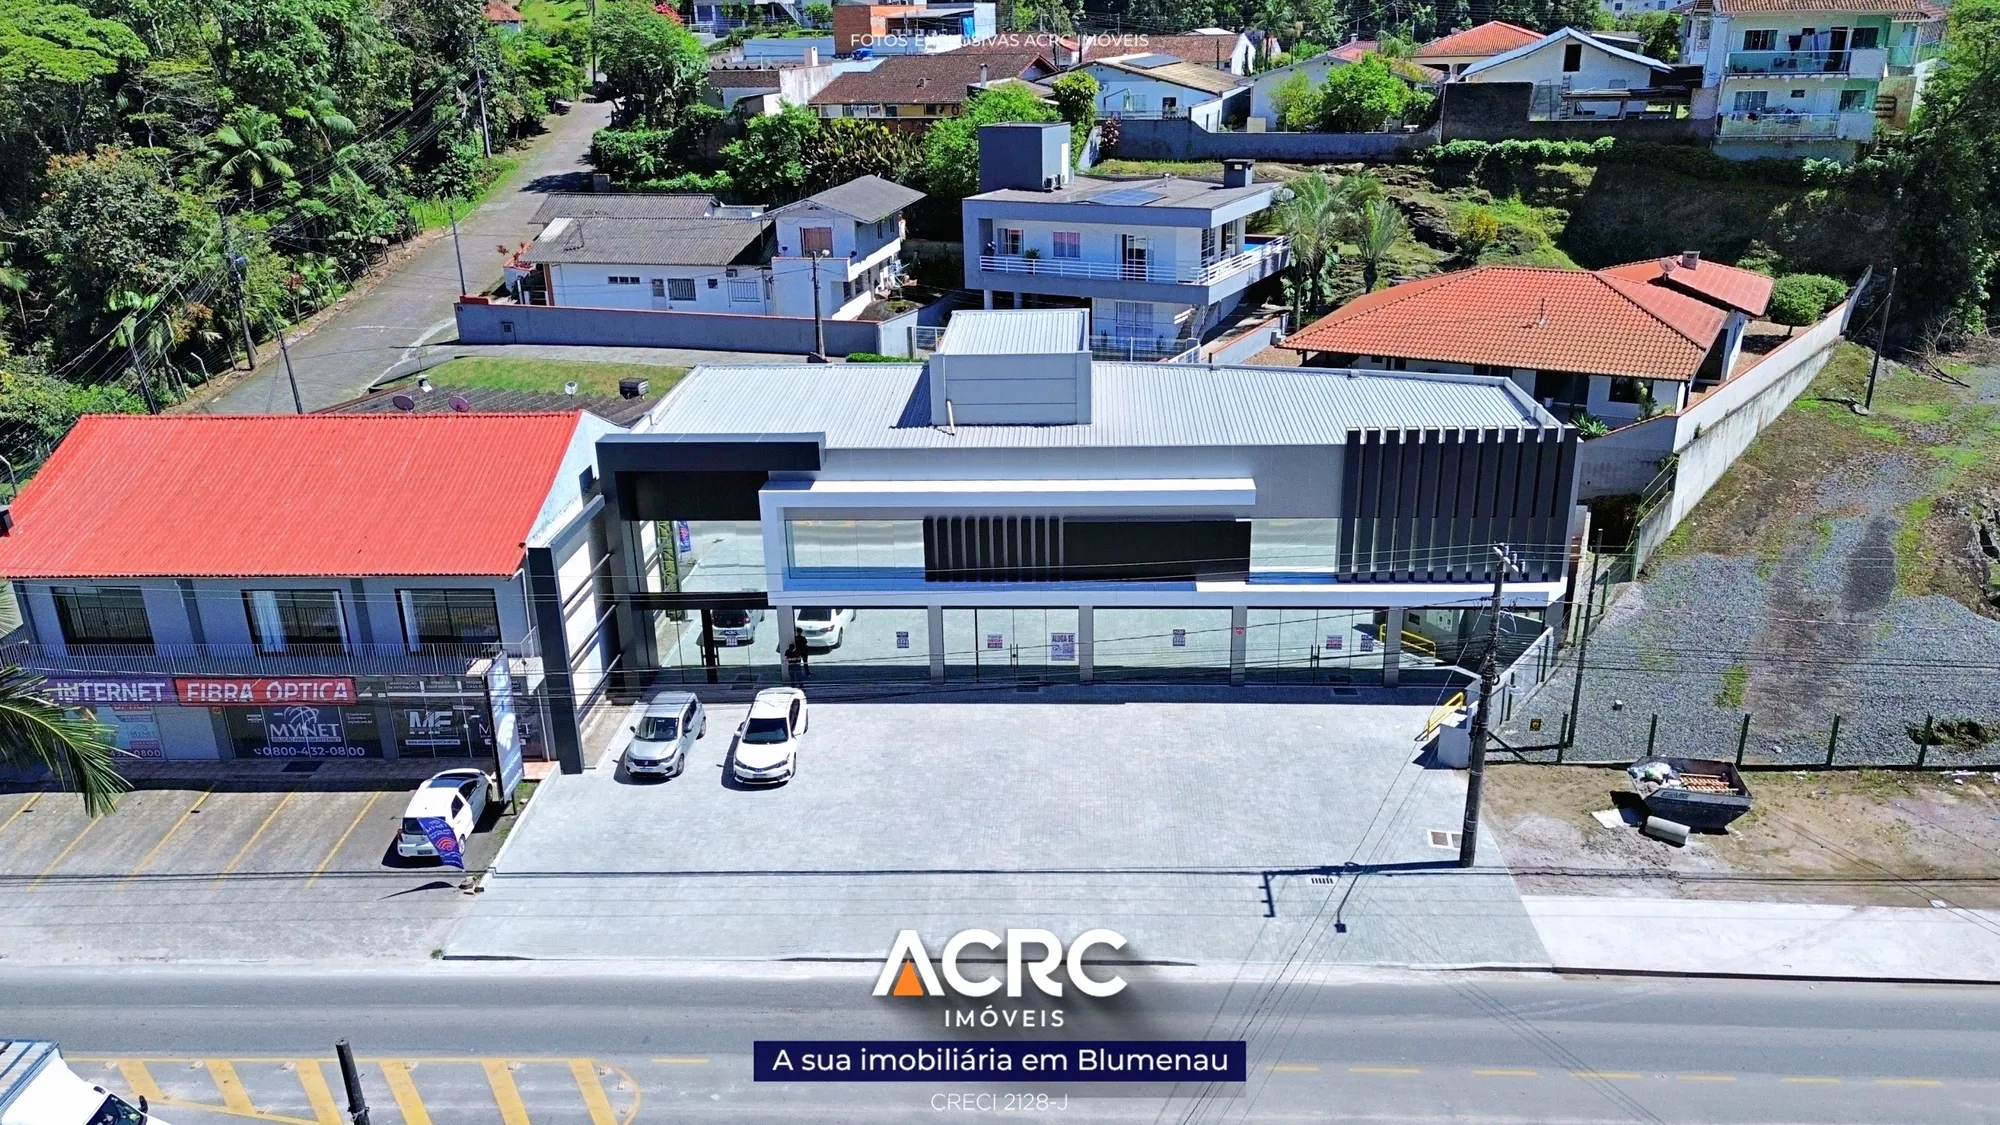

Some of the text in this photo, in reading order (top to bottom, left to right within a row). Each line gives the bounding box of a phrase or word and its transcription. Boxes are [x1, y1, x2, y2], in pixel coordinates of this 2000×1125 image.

[57, 682, 165, 701] INTERNET
[187, 681, 348, 702] FIBRA ÓPTICA
[269, 723, 340, 737] MYNET
[262, 746, 366, 757] 0800-432-0800
